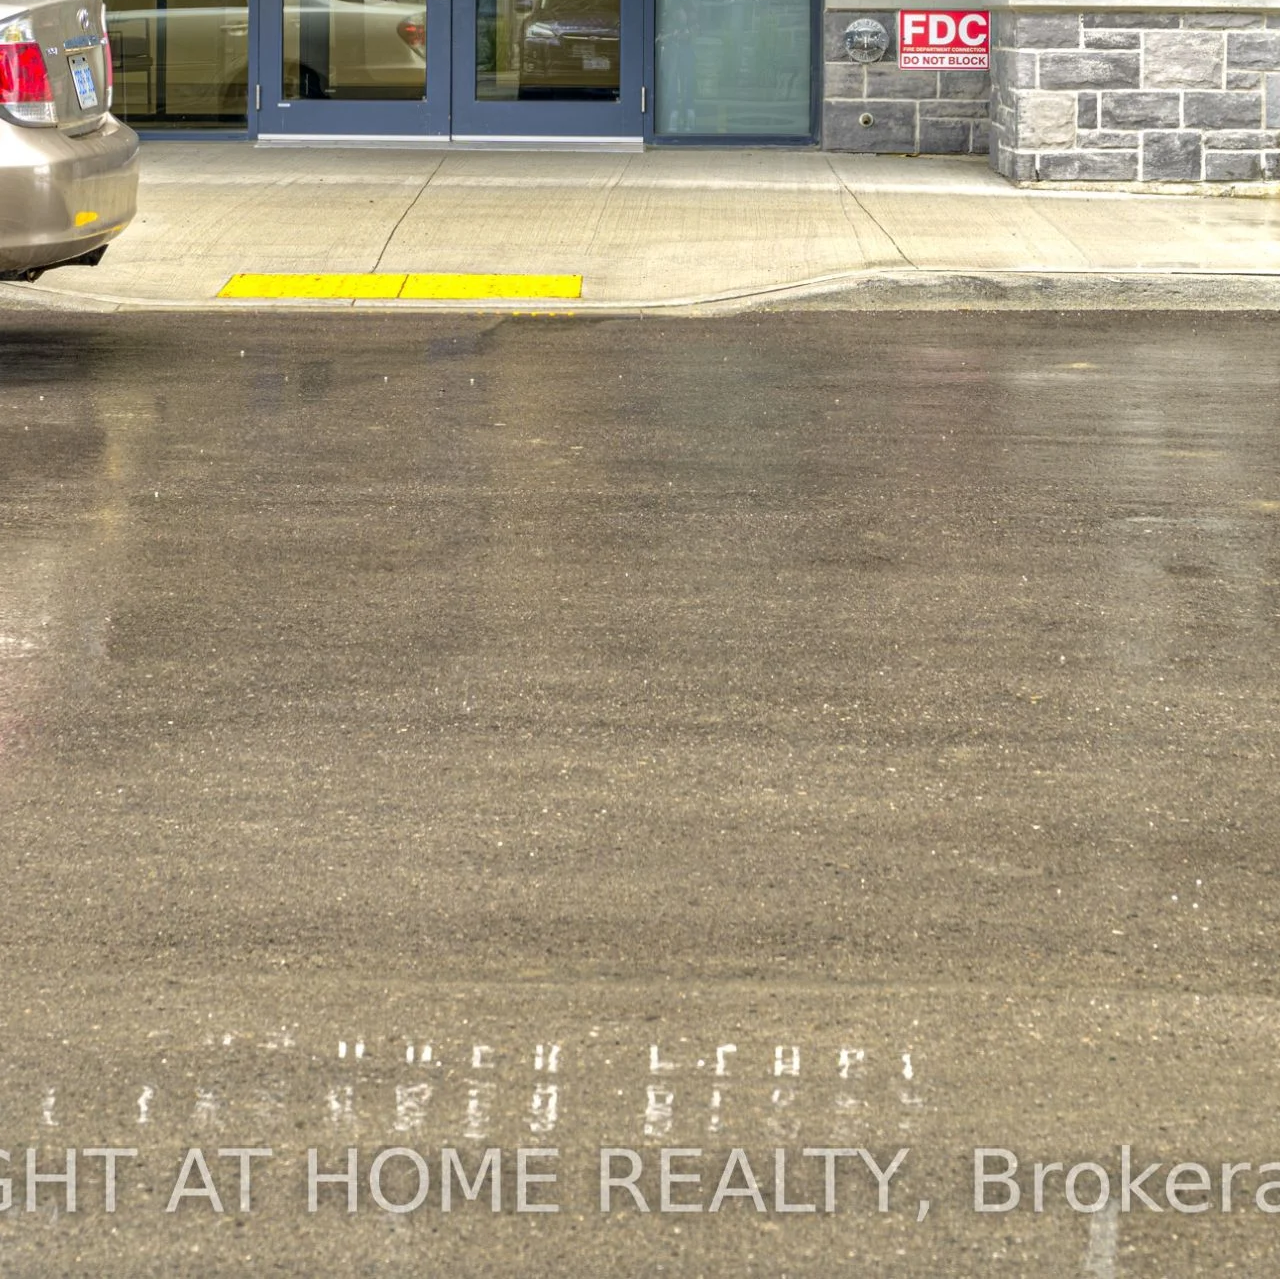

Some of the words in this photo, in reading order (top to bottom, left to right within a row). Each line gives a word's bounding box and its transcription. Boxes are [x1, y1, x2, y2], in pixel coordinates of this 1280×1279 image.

[903, 13, 987, 46] FDC
[903, 56, 919, 65] DO
[922, 56, 945, 65] NOT
[948, 56, 986, 66] BLOCK
